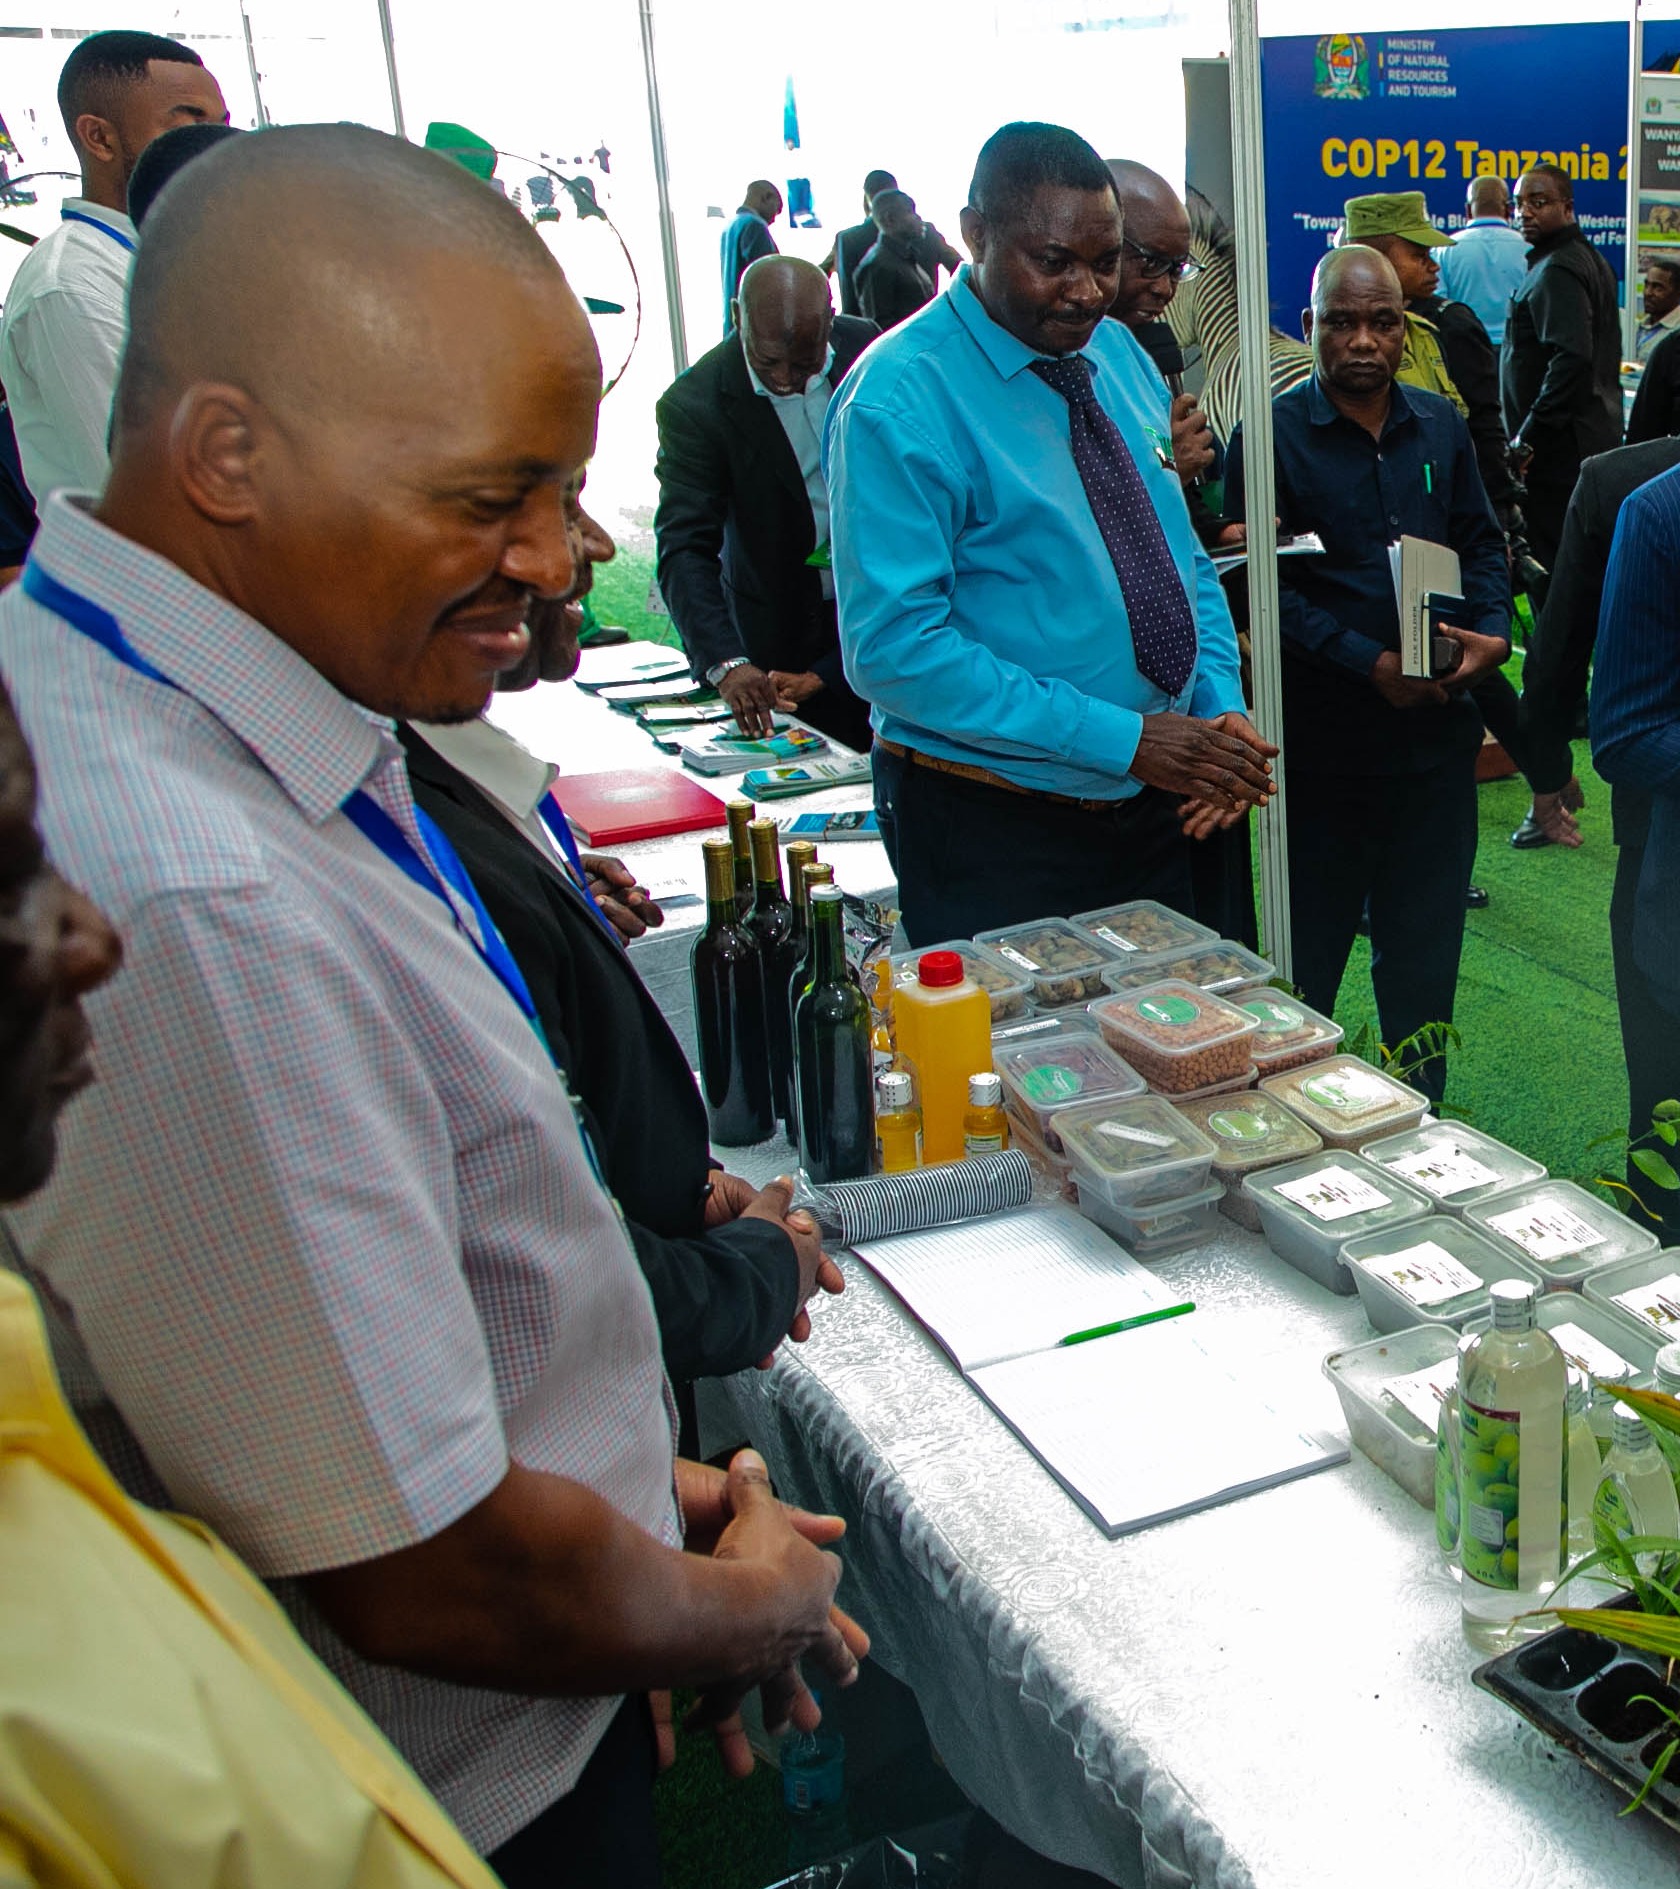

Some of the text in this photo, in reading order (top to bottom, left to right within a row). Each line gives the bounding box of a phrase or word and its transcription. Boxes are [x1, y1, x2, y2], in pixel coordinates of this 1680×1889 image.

[1387, 38, 1436, 51] MINISTRY
[1387, 54, 1450, 67] OF NATURAL
[1388, 69, 1448, 82] RESOURCES
[1388, 85, 1457, 98] AND TOURISM
[1321, 137, 1447, 178] COP12
[1593, 231, 1606, 245] of
